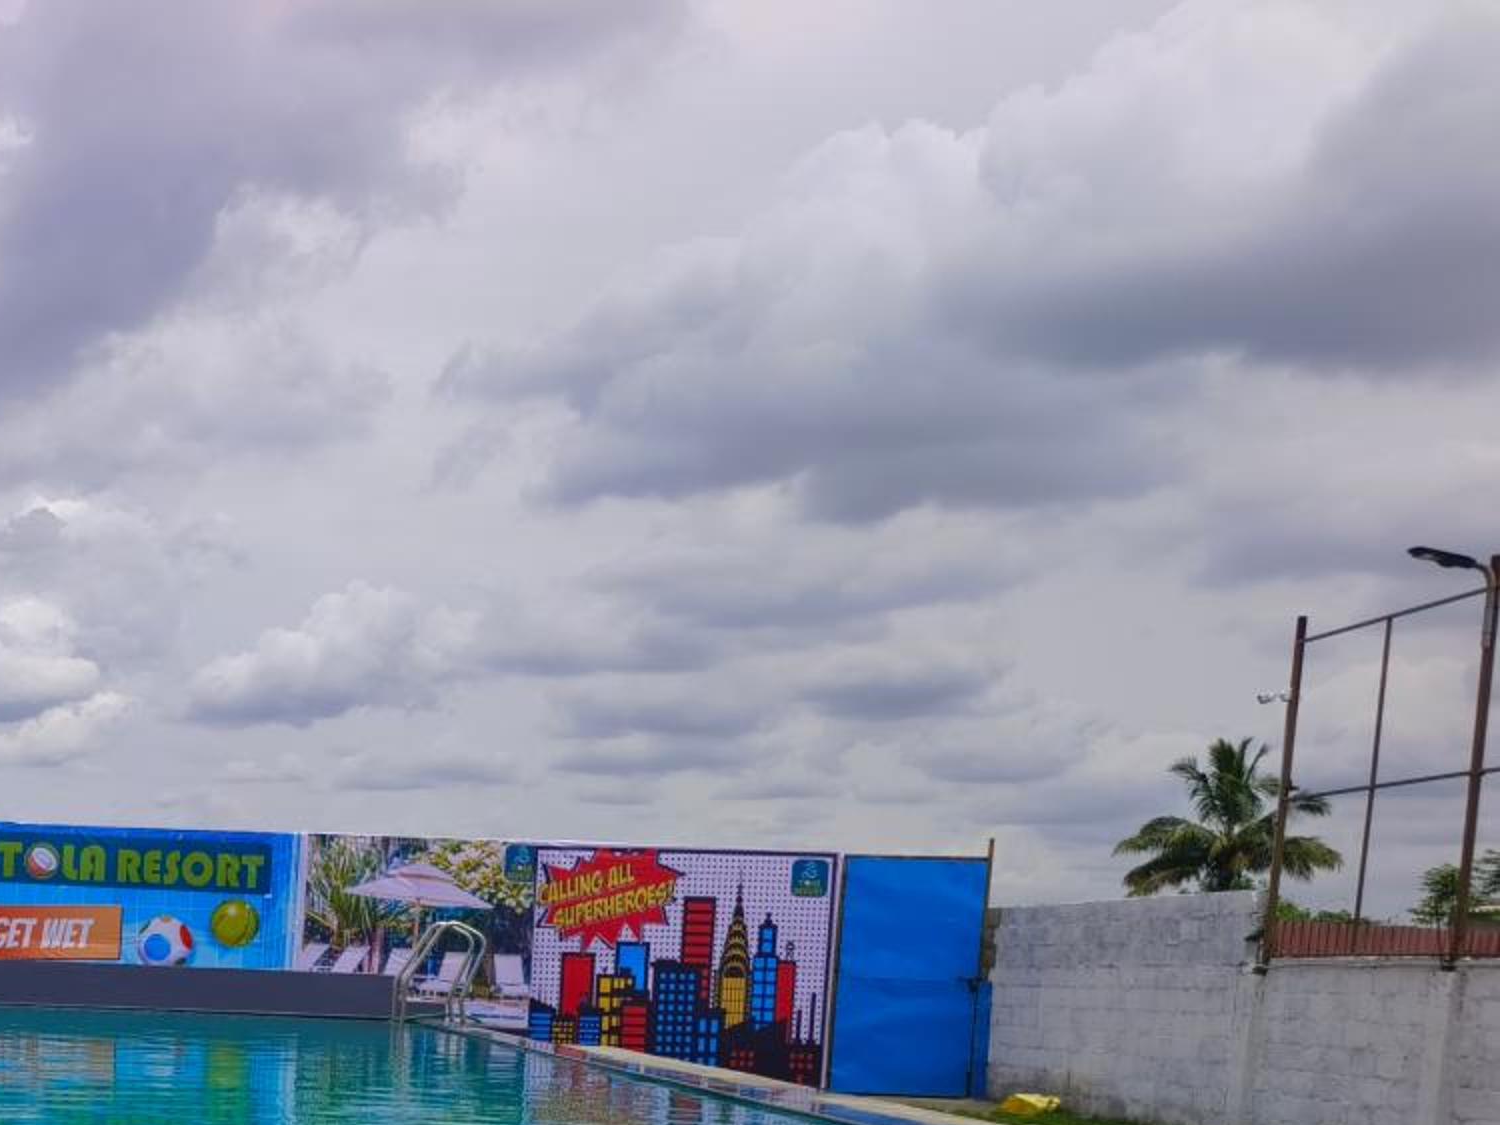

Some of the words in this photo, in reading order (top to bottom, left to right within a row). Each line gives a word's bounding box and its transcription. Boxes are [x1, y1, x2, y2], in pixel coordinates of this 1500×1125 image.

[116, 848, 265, 889] RESORT
[539, 870, 605, 906] CALLING
[608, 862, 636, 888] ALL
[39, 917, 95, 949] WET
